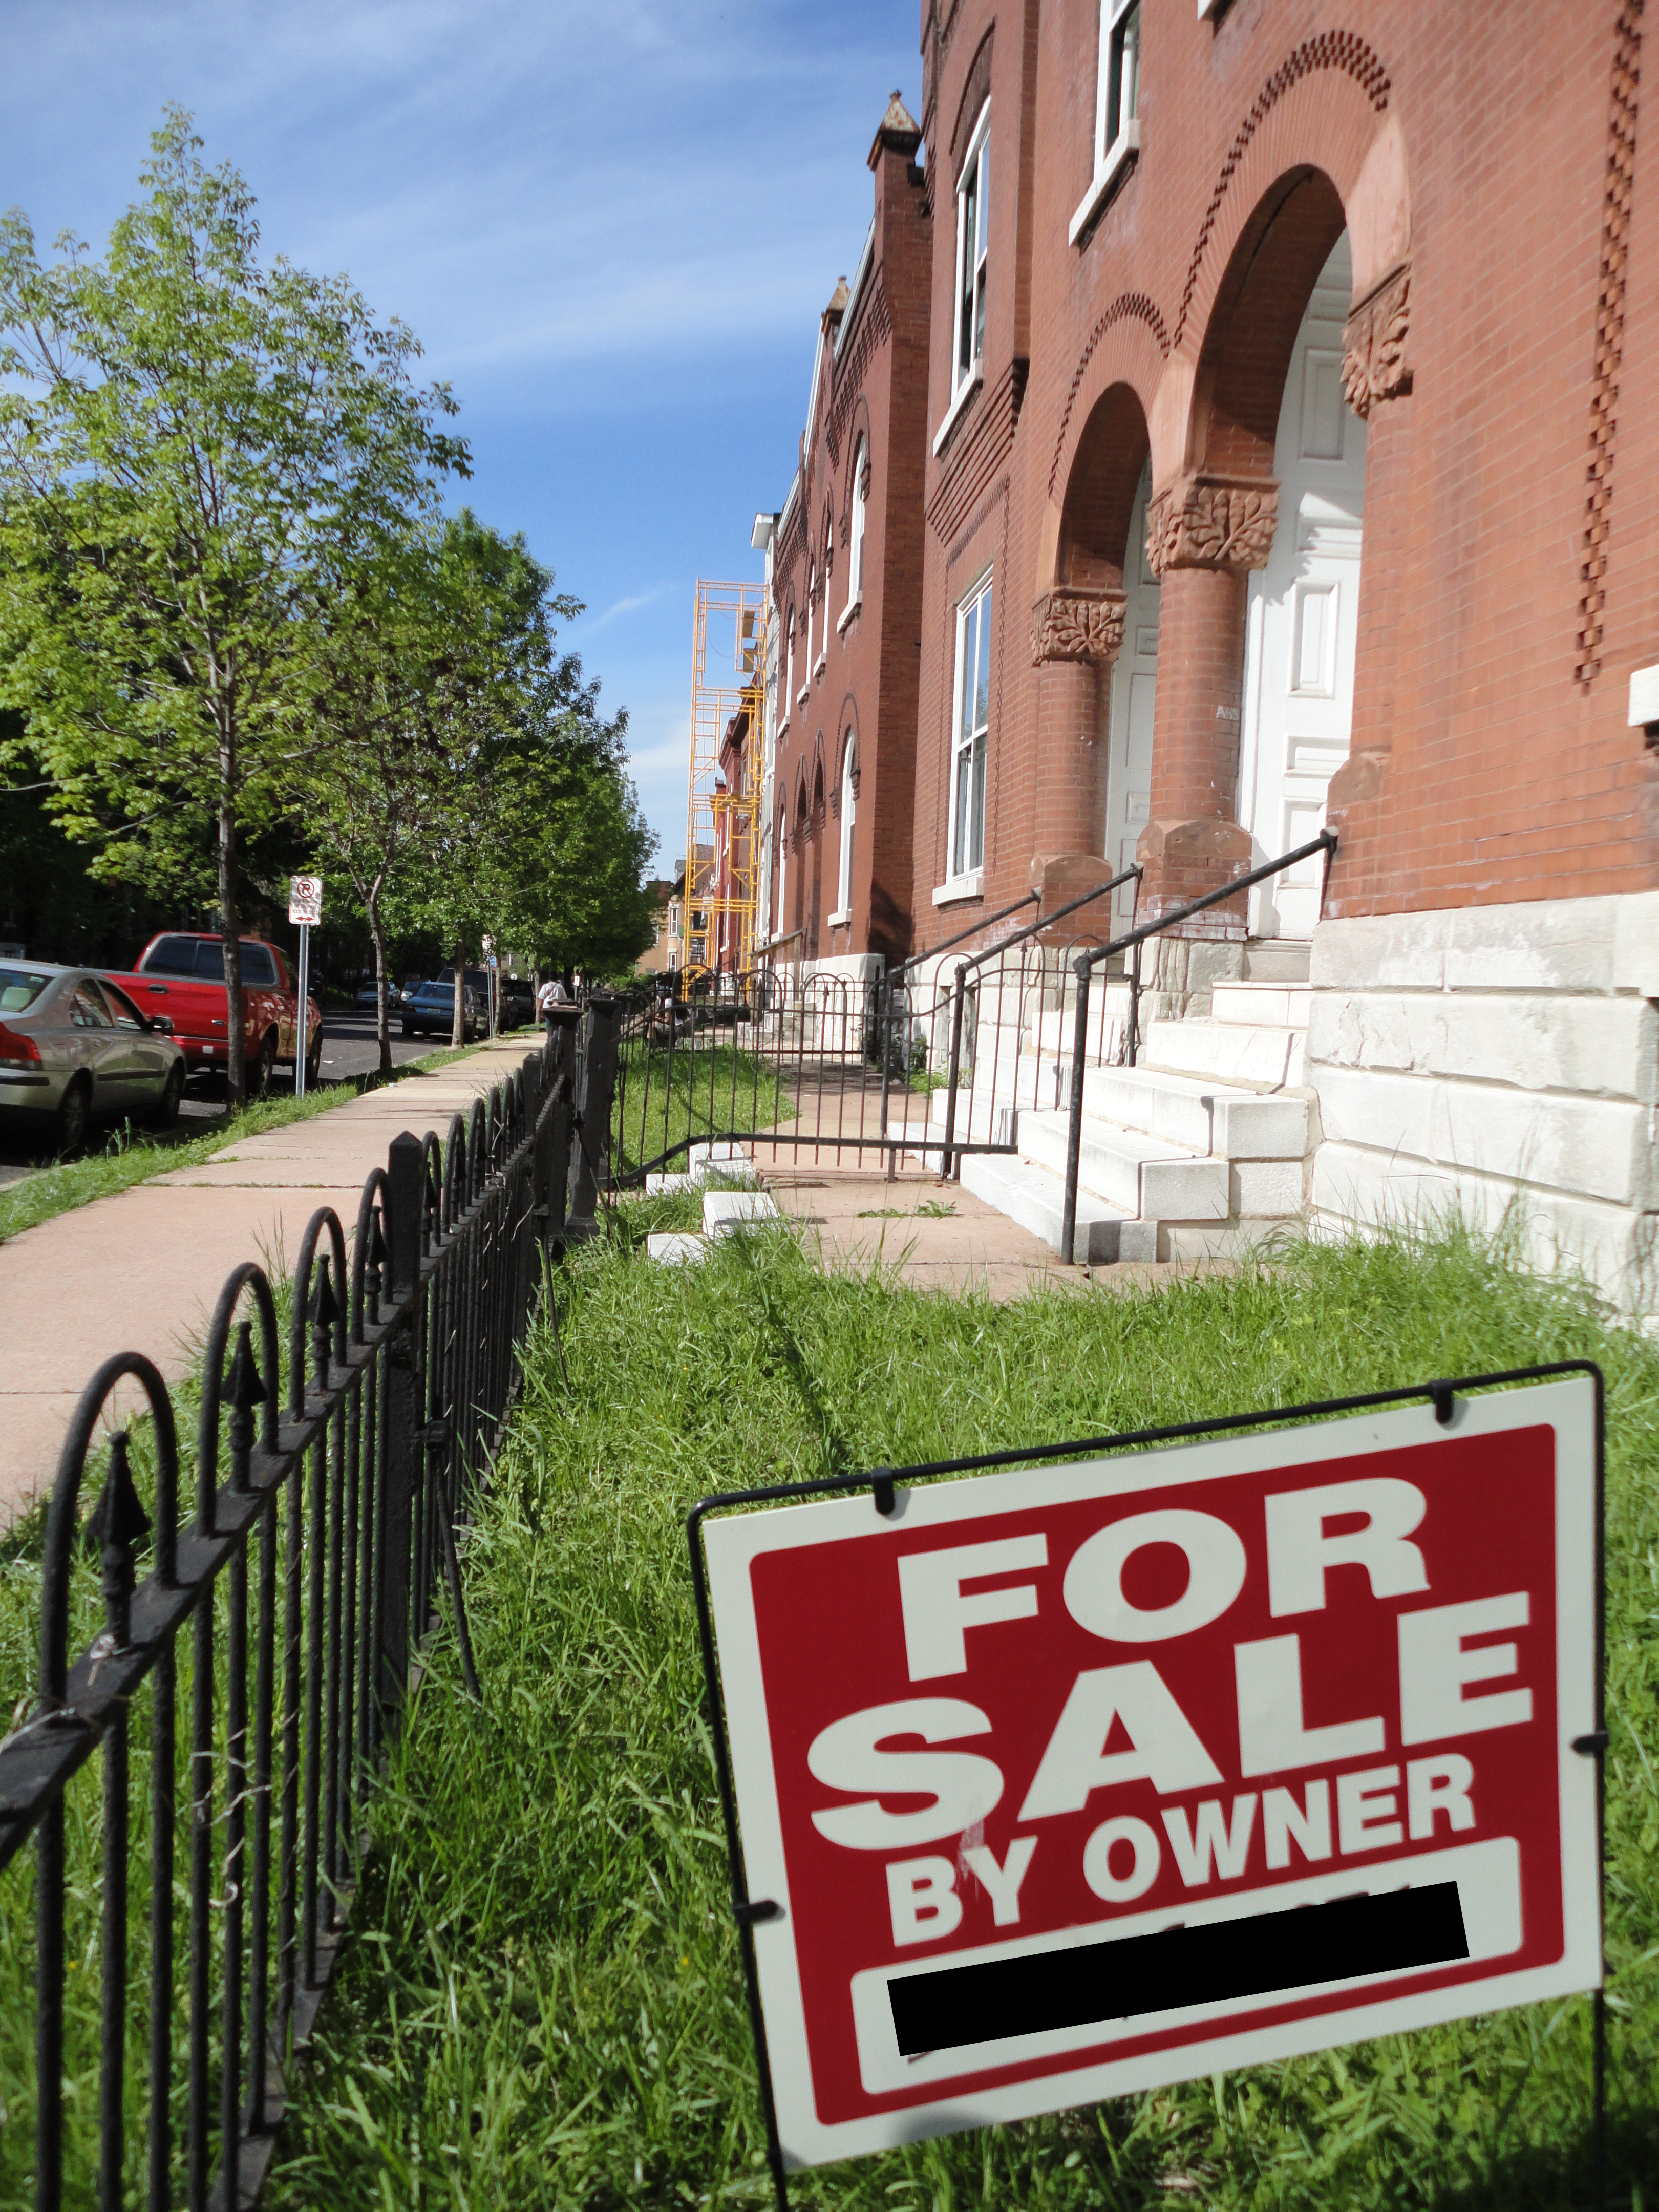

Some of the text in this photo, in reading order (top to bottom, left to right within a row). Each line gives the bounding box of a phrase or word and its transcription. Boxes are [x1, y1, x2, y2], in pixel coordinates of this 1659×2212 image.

[897, 1478, 1431, 1682] FOR
[807, 1591, 1533, 1850] SALE
[885, 1753, 1476, 1947] BY OWNER
